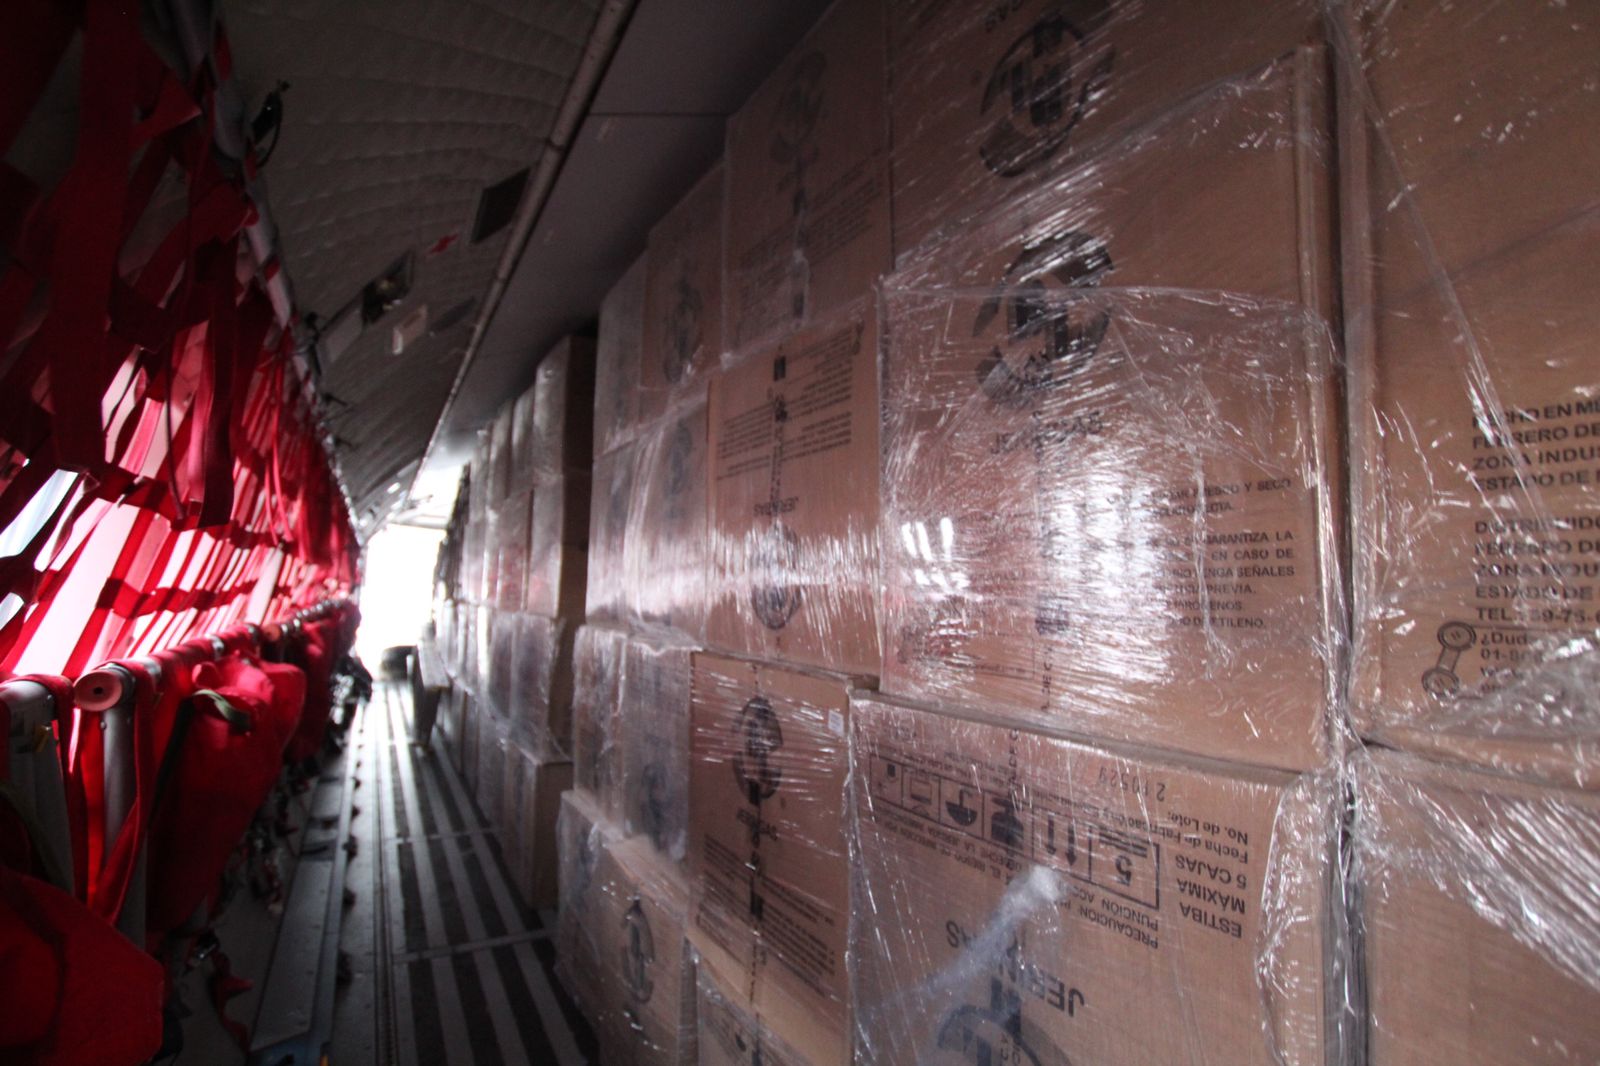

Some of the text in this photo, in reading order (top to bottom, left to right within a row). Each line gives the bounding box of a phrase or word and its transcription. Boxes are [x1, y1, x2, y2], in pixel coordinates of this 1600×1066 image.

[1543, 402, 1572, 419] EN
[1538, 446, 1600, 464] INDU
[1244, 481, 1252, 492] Y
[1560, 469, 1590, 486] DE
[1275, 530, 1294, 541] LA
[1211, 548, 1294, 561] EN CASO DE
[1237, 565, 1296, 577] SEÑALES
[1167, 810, 1248, 846] No. de Lote:
[1204, 837, 1249, 864] Fecha
[1114, 854, 1134, 887] 5
[1174, 853, 1248, 890] 5 CAJAS
[1176, 877, 1247, 916] MÁXIMA
[1101, 898, 1159, 932] PUNCIÓN
[1178, 901, 1243, 939] ESTIBA
